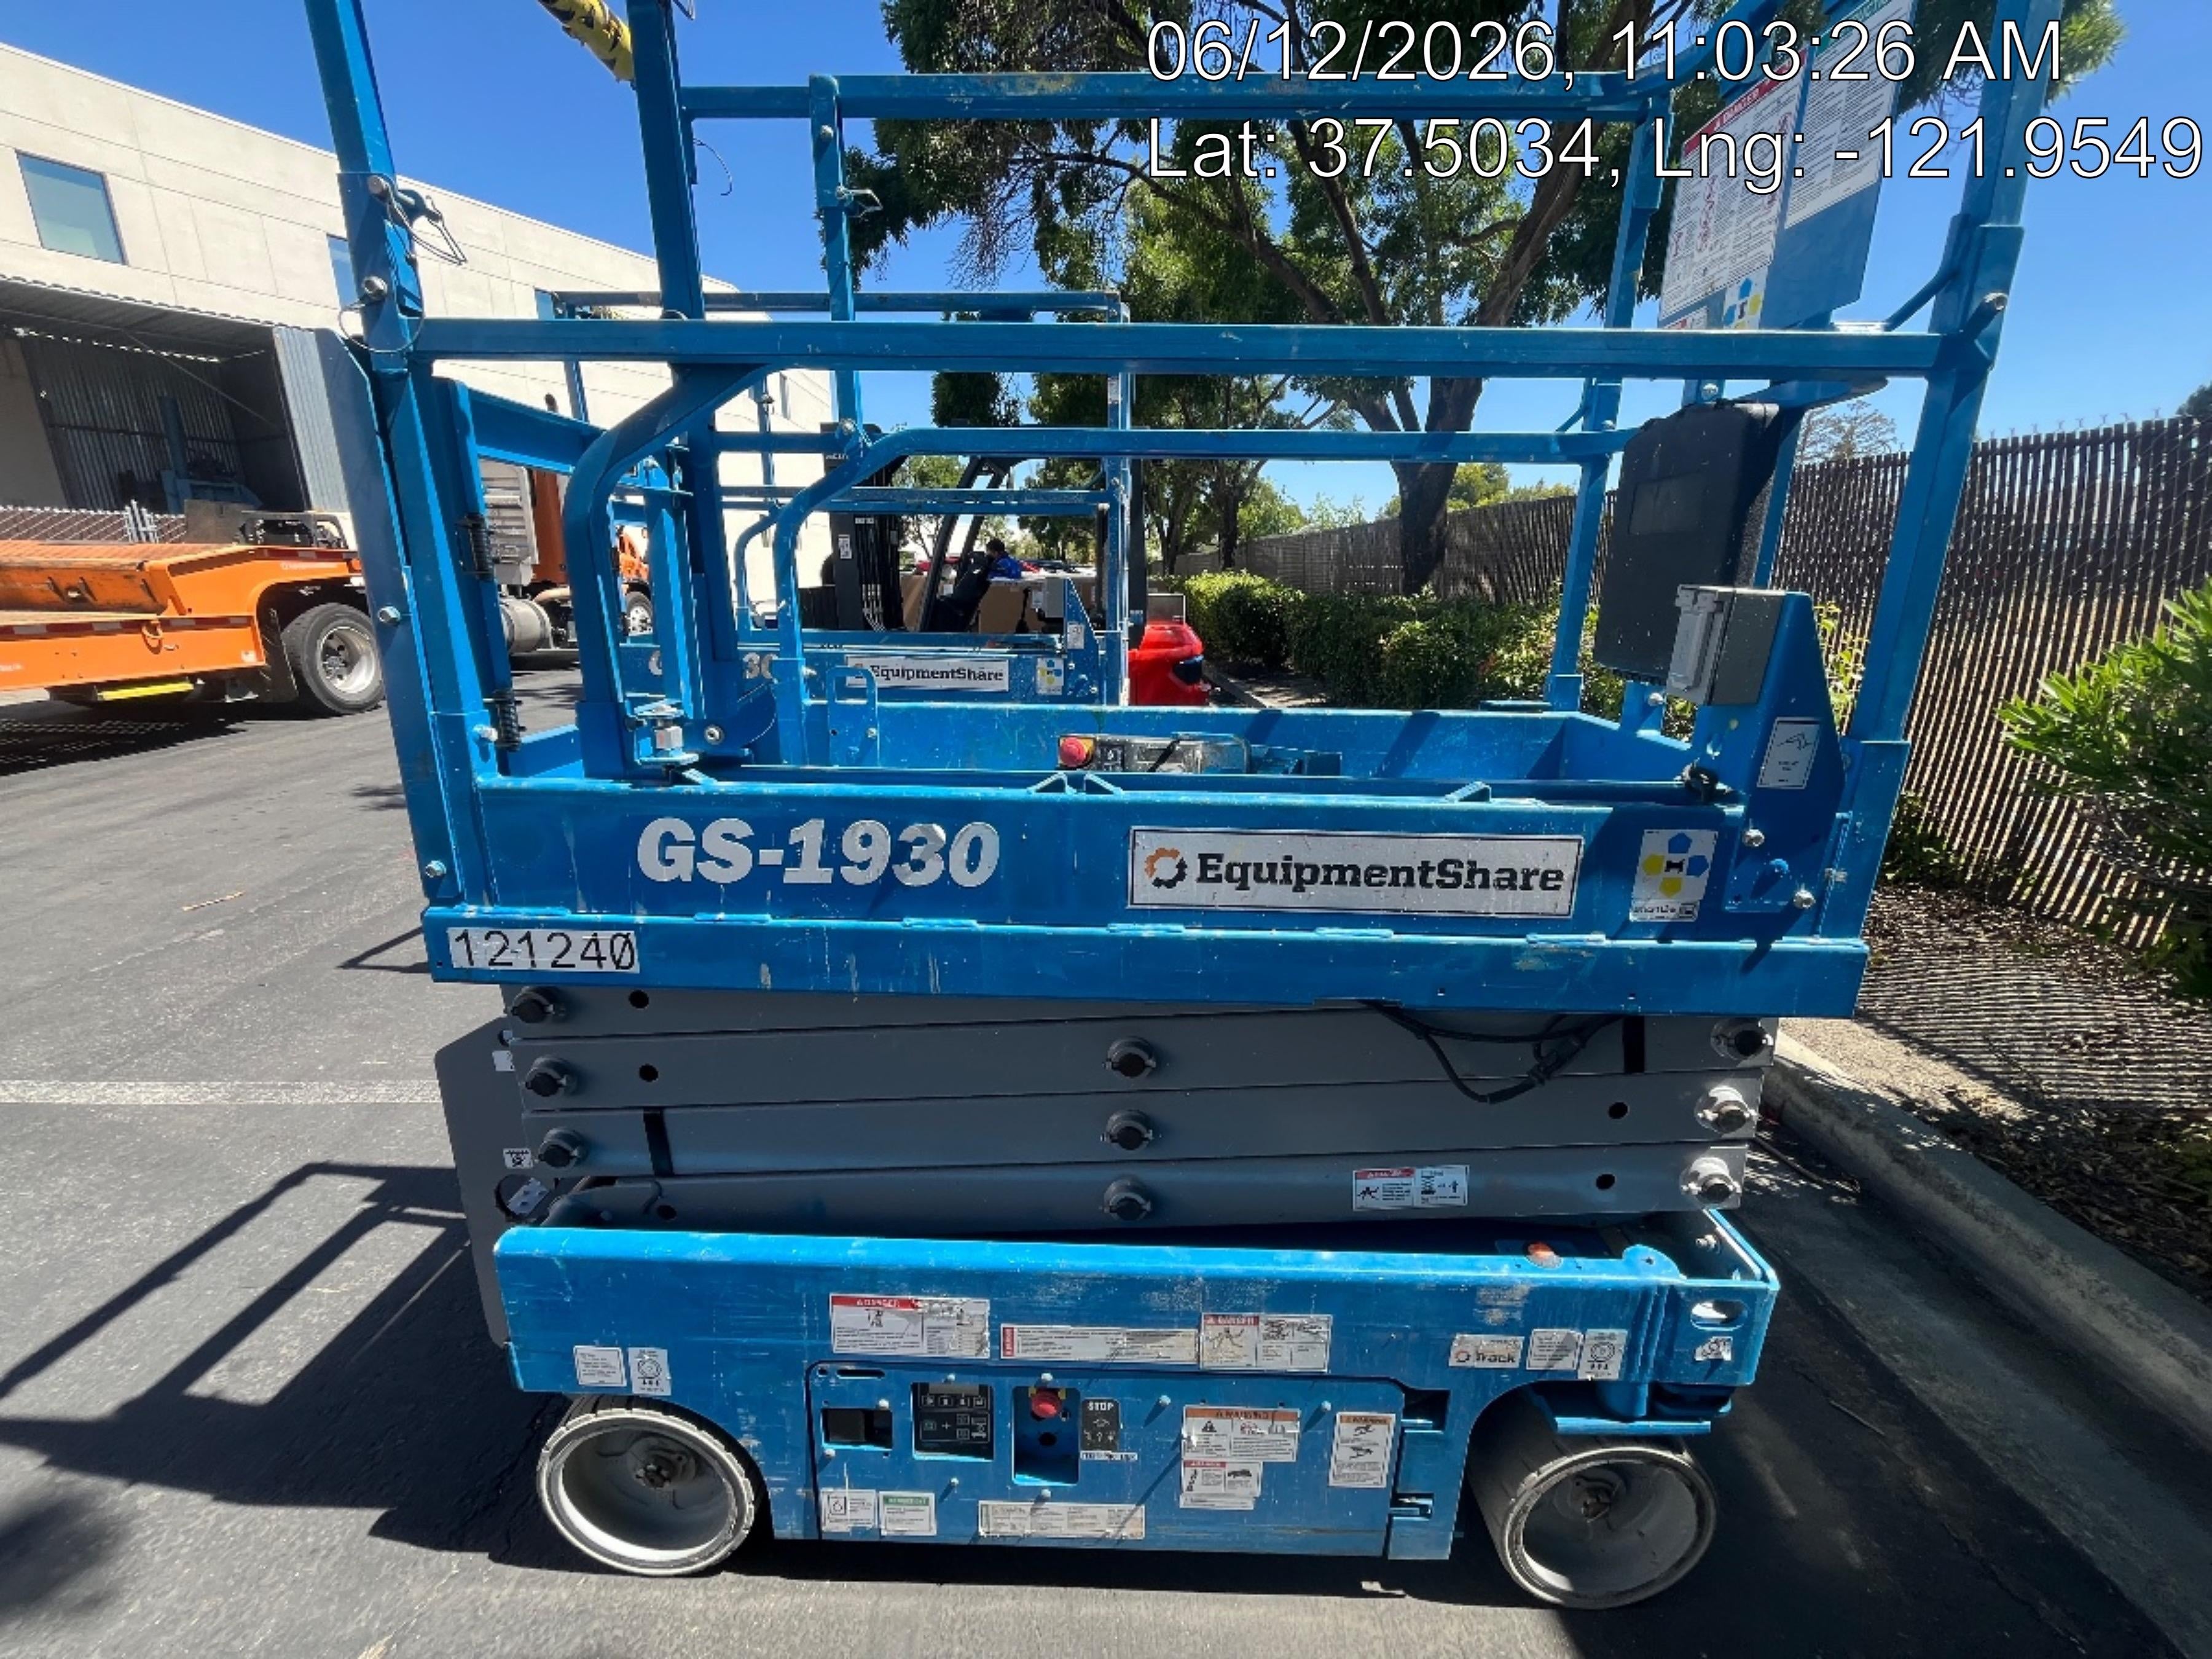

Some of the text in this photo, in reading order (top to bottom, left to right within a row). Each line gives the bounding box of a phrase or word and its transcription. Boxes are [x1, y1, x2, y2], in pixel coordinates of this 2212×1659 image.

[870, 665, 1003, 681] EquipmentShare
[637, 817, 1000, 888] GS-1930
[1196, 852, 1564, 893] EquipmentShare
[453, 929, 637, 971] 121240
[1475, 1351, 1516, 1363] Track
[1087, 1402, 1114, 1411] STOP
